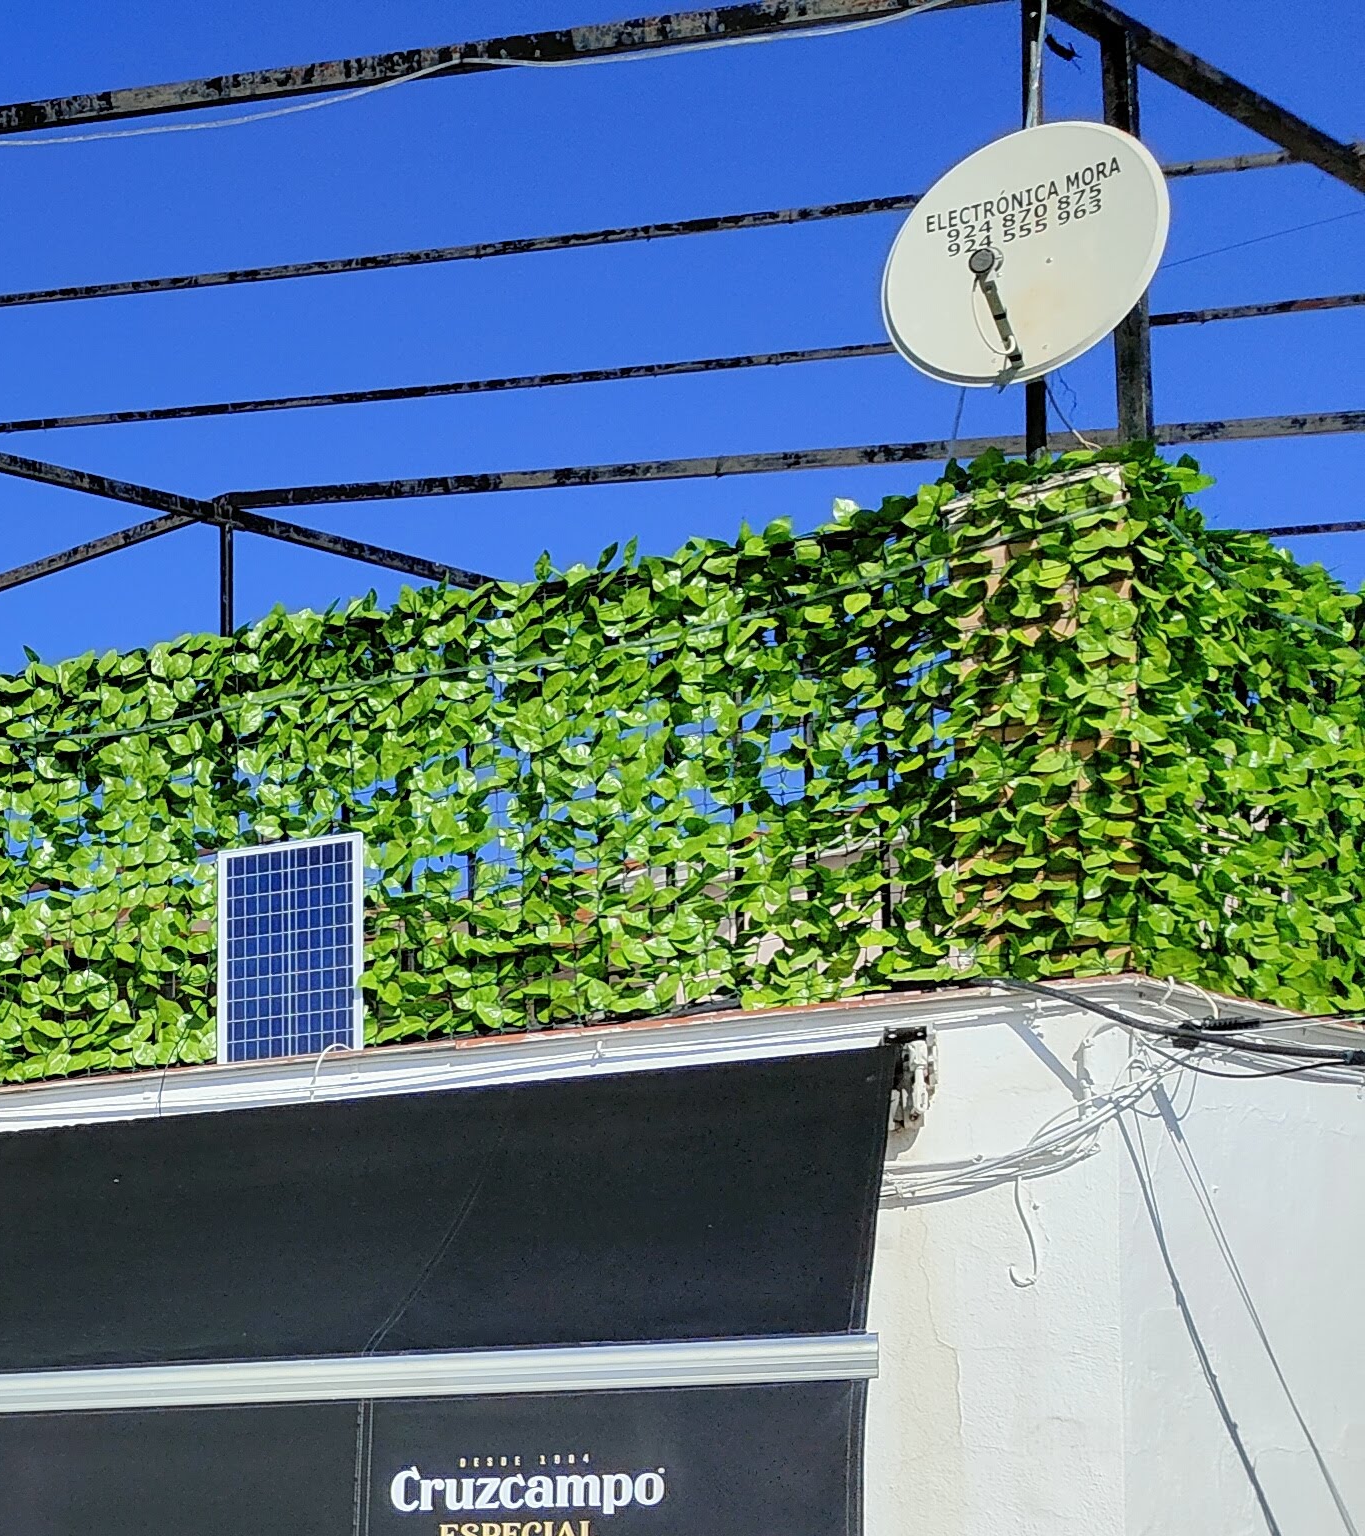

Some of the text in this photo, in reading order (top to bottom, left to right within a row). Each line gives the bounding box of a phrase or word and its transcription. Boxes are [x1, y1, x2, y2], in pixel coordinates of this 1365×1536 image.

[926, 157, 1121, 233] ELECTRÓNICA MORA
[947, 183, 1102, 243] 924 870 875
[947, 198, 1102, 257] 924 555 963
[390, 1466, 665, 1515] Cruzcampo
